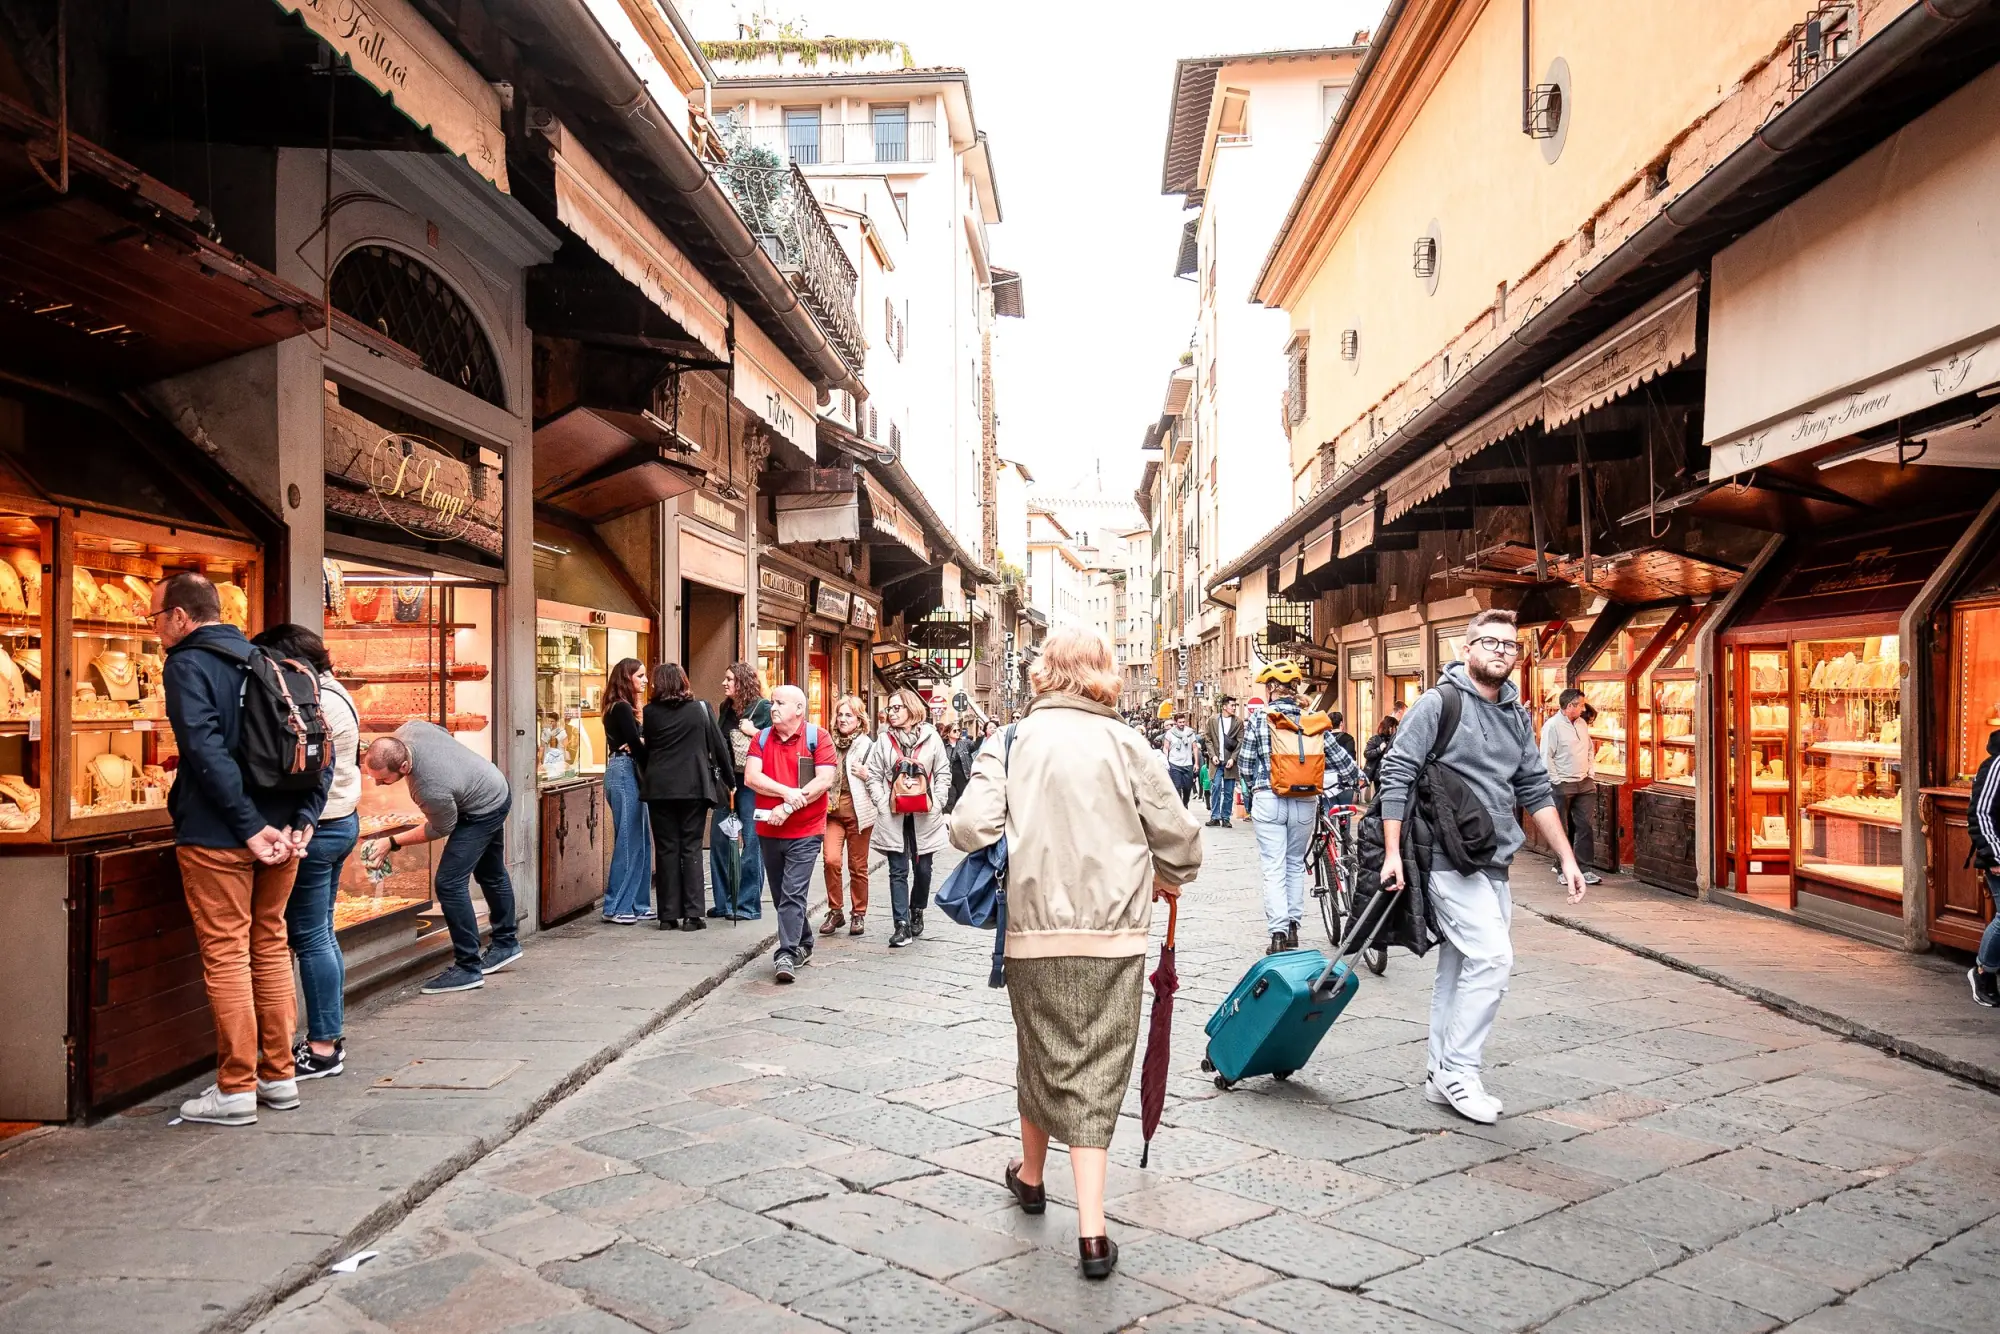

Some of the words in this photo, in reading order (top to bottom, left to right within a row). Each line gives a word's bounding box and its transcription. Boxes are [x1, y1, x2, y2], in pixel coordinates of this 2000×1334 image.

[333, 0, 408, 91] Fallaci
[1792, 410, 1837, 442] Firenze
[1838, 389, 1892, 424] Forever
[416, 458, 468, 526] Vaggi
[1004, 632, 1014, 698] PICCINI
[1177, 637, 1190, 686] GLOVES
